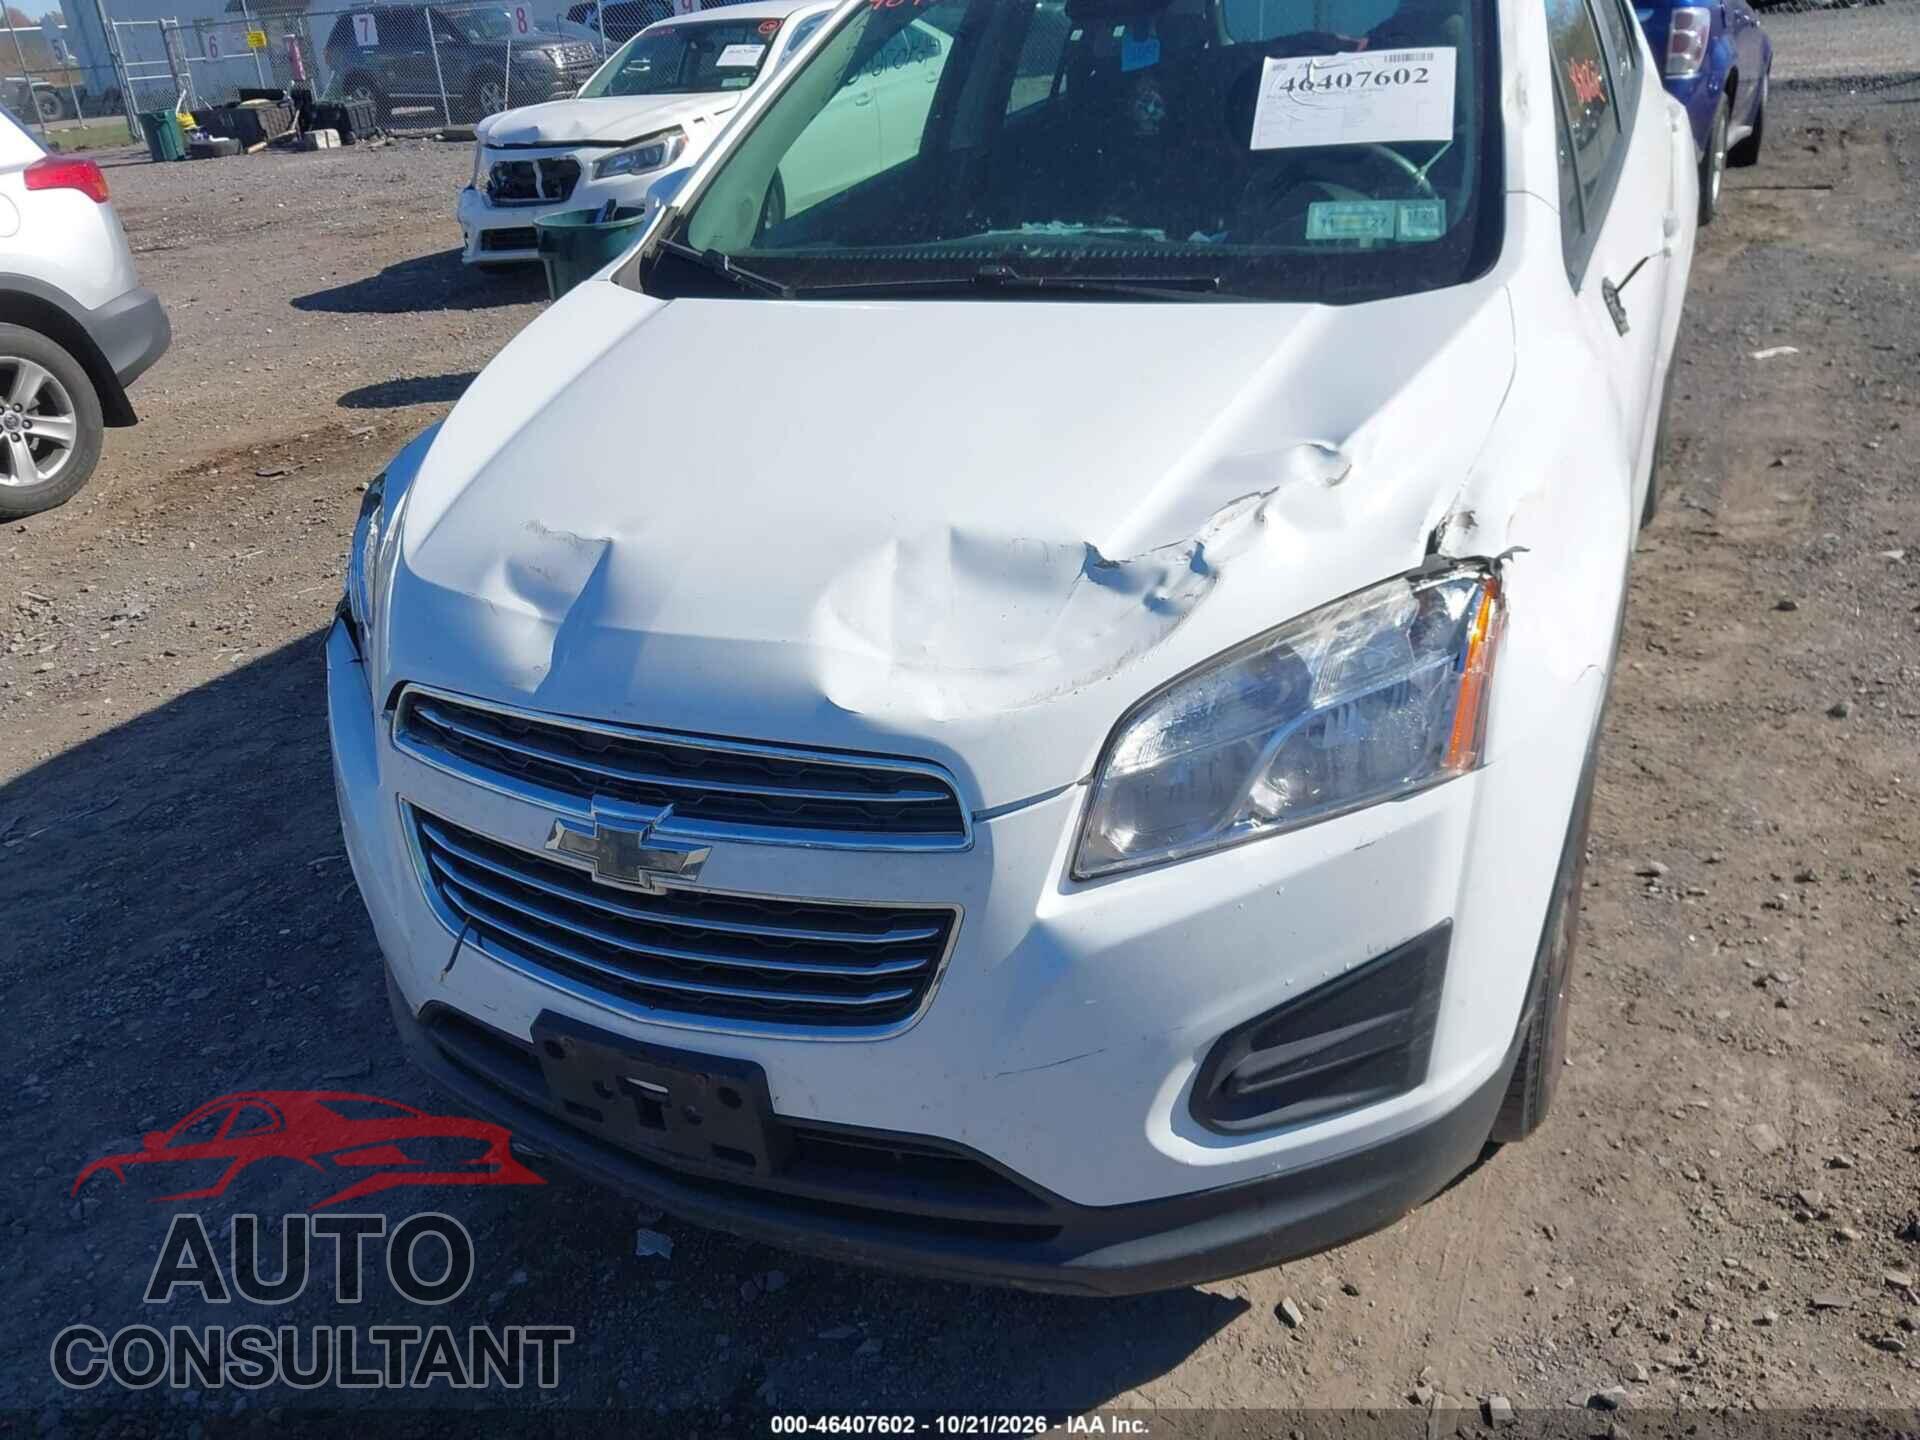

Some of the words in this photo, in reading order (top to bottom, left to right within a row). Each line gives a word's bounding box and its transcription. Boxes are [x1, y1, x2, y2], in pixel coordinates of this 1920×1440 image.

[359, 17, 369, 42] 7
[516, 7, 528, 34] 8
[208, 35, 218, 58] 6
[1279, 67, 1430, 92] 46407602
